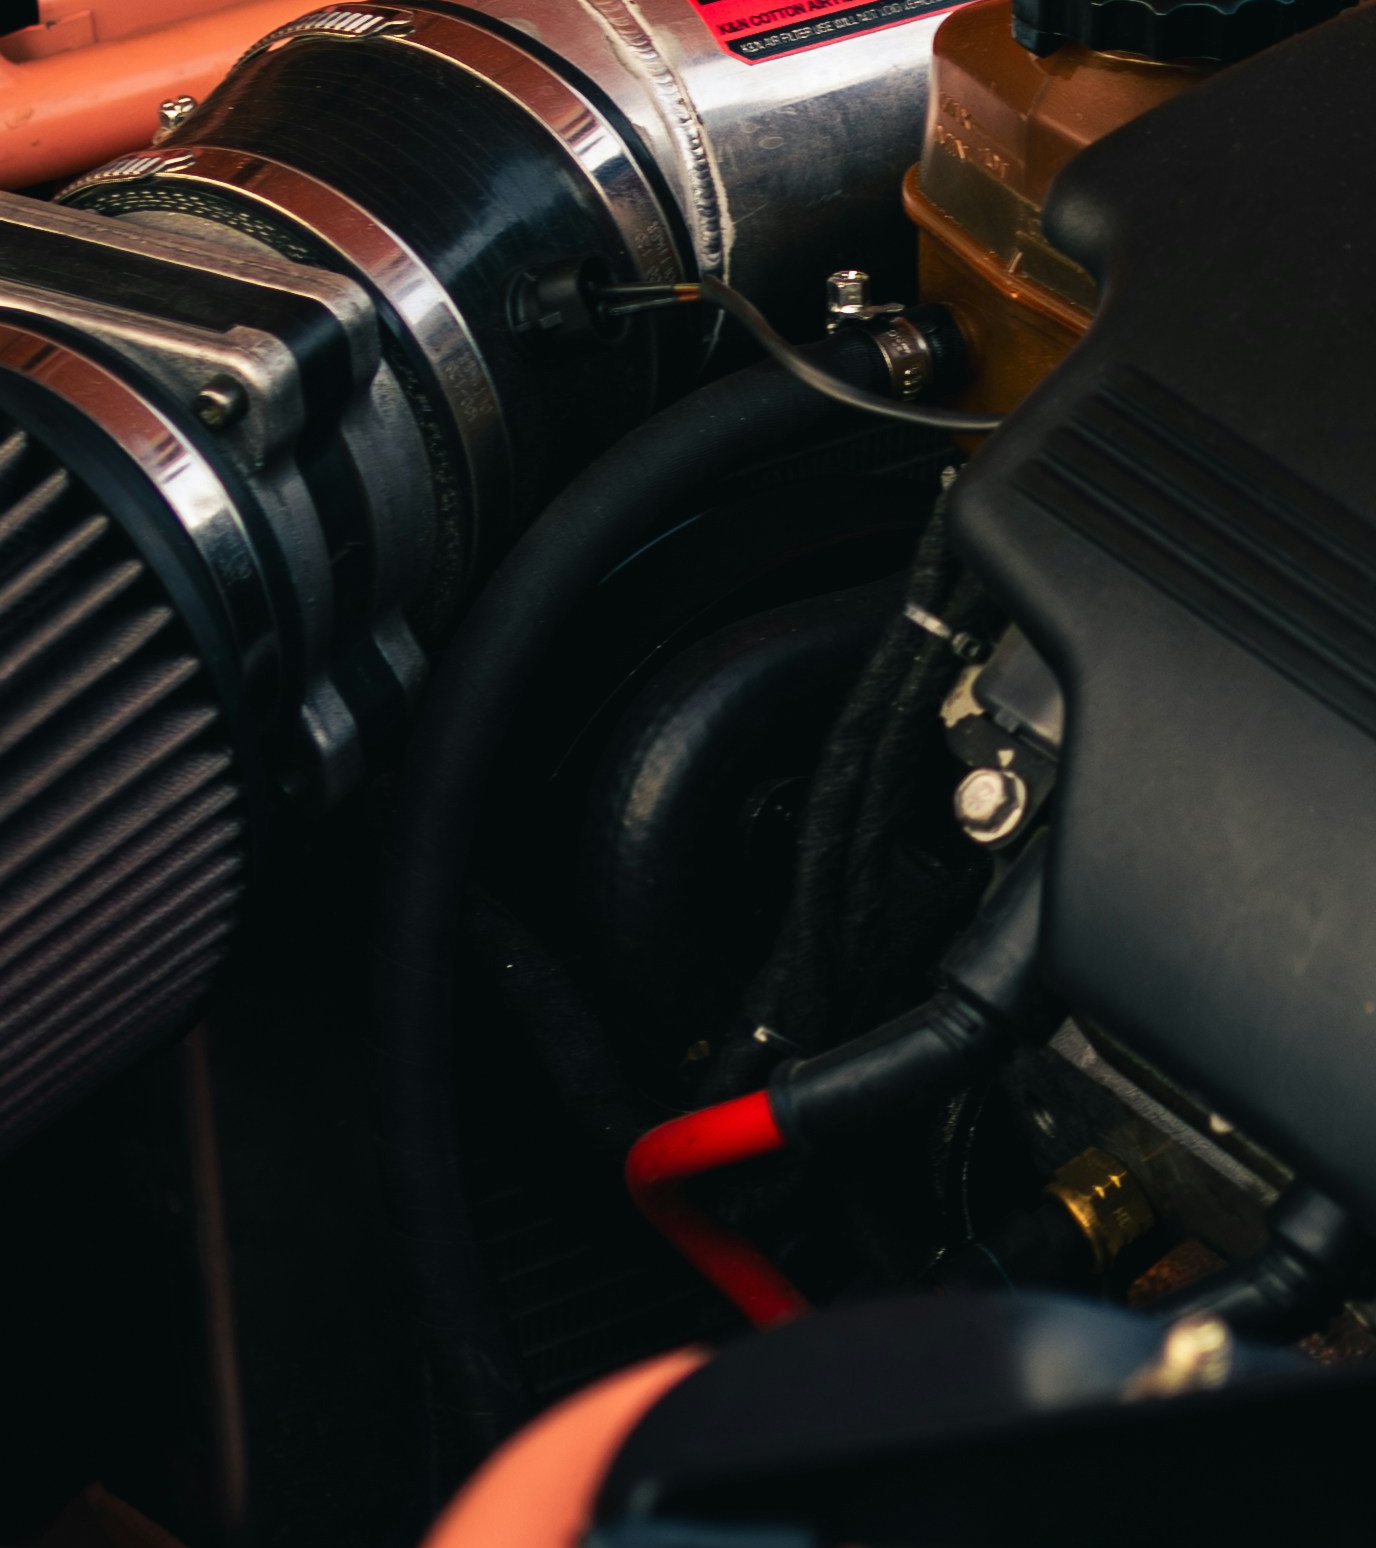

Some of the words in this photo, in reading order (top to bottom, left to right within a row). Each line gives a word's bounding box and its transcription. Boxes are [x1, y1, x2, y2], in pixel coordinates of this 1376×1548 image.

[717, 17, 750, 35] K&N
[749, 3, 806, 26] COTTON
[779, 26, 813, 43] FILTER
